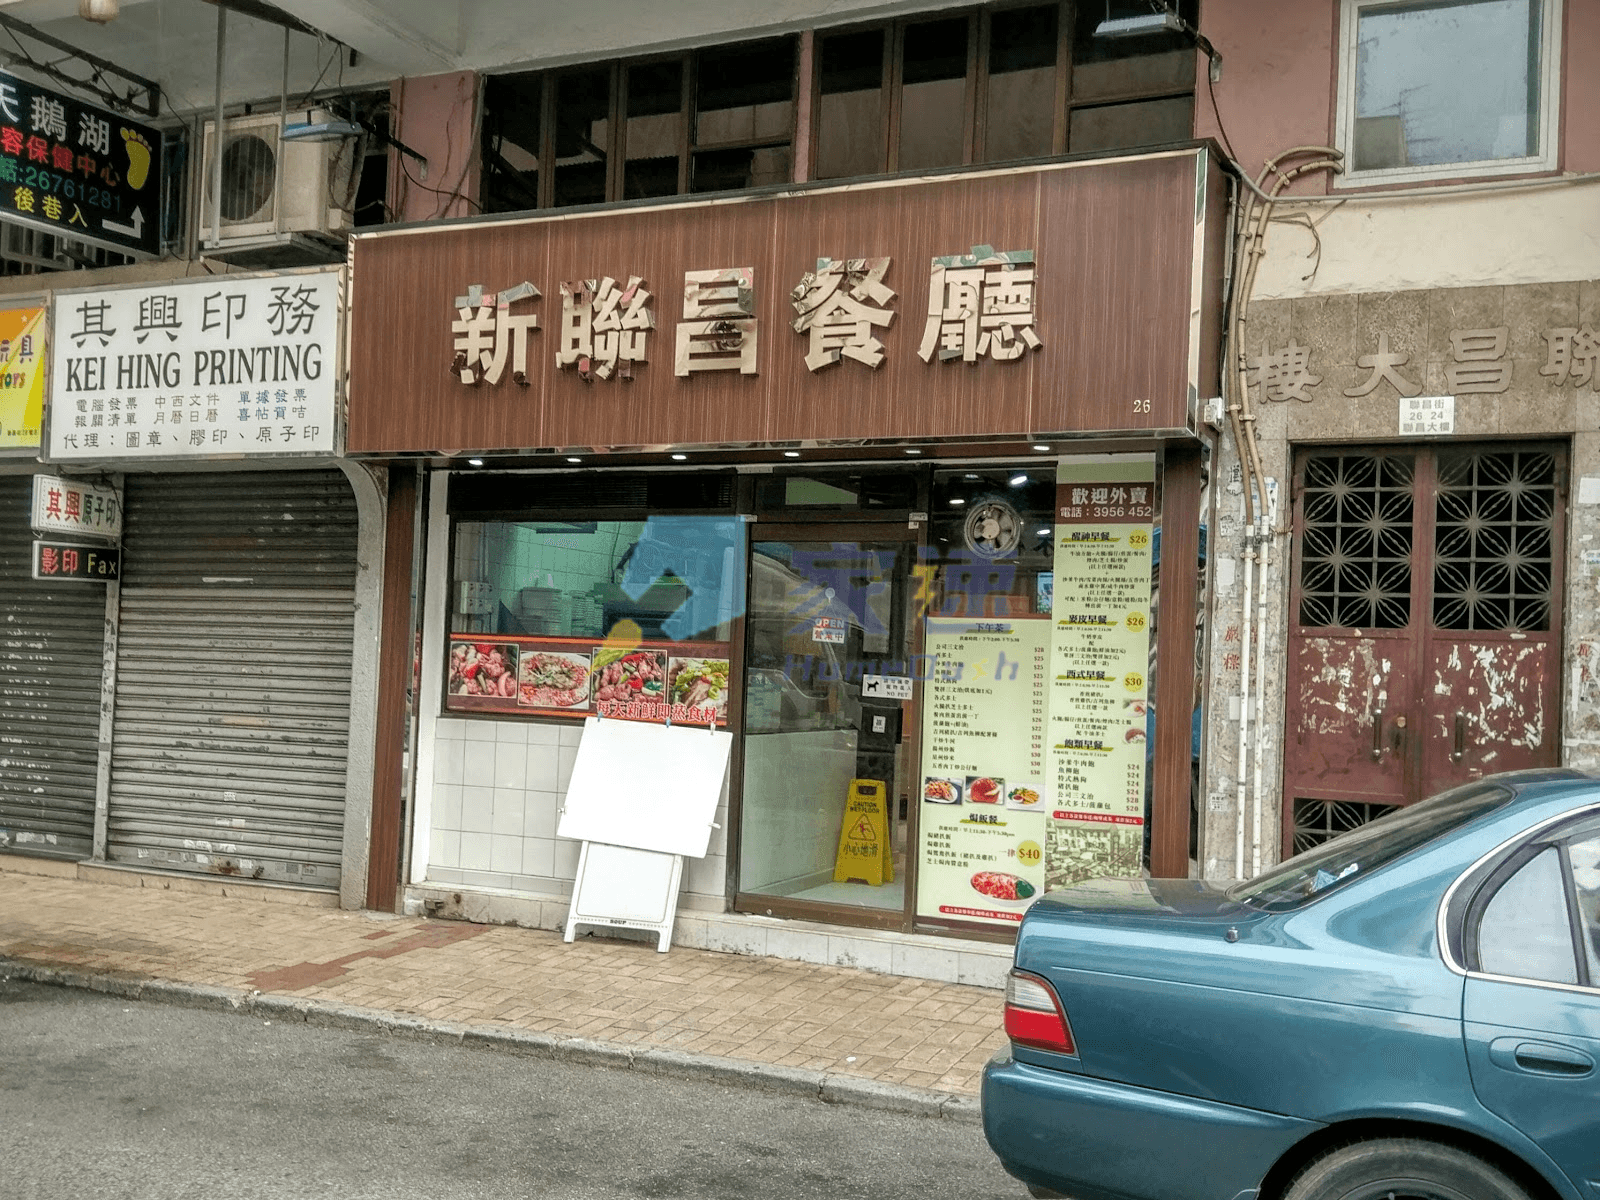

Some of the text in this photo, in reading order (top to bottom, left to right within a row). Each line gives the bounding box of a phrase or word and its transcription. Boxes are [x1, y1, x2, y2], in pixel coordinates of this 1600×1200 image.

[71, 283, 321, 348] 其興印務
[450, 244, 1043, 387] 新聯昌餐廳
[66, 343, 321, 392] KEI HING PRINTING
[156, 393, 219, 408] 中西文件
[239, 388, 307, 405] 單據發票
[1133, 399, 1151, 414] 26
[1409, 411, 1444, 421] 26 24
[1072, 487, 1148, 505] 歡迎外賣
[47, 487, 115, 528] 其興原子印
[1094, 506, 1124, 517] 3956
[1130, 535, 1147, 544] $26
[42, 547, 116, 575] 影印 Fax
[976, 622, 1004, 633] 下午茶
[1127, 617, 1144, 626] $26
[1125, 677, 1142, 687] $30
[1018, 848, 1041, 860] $40
